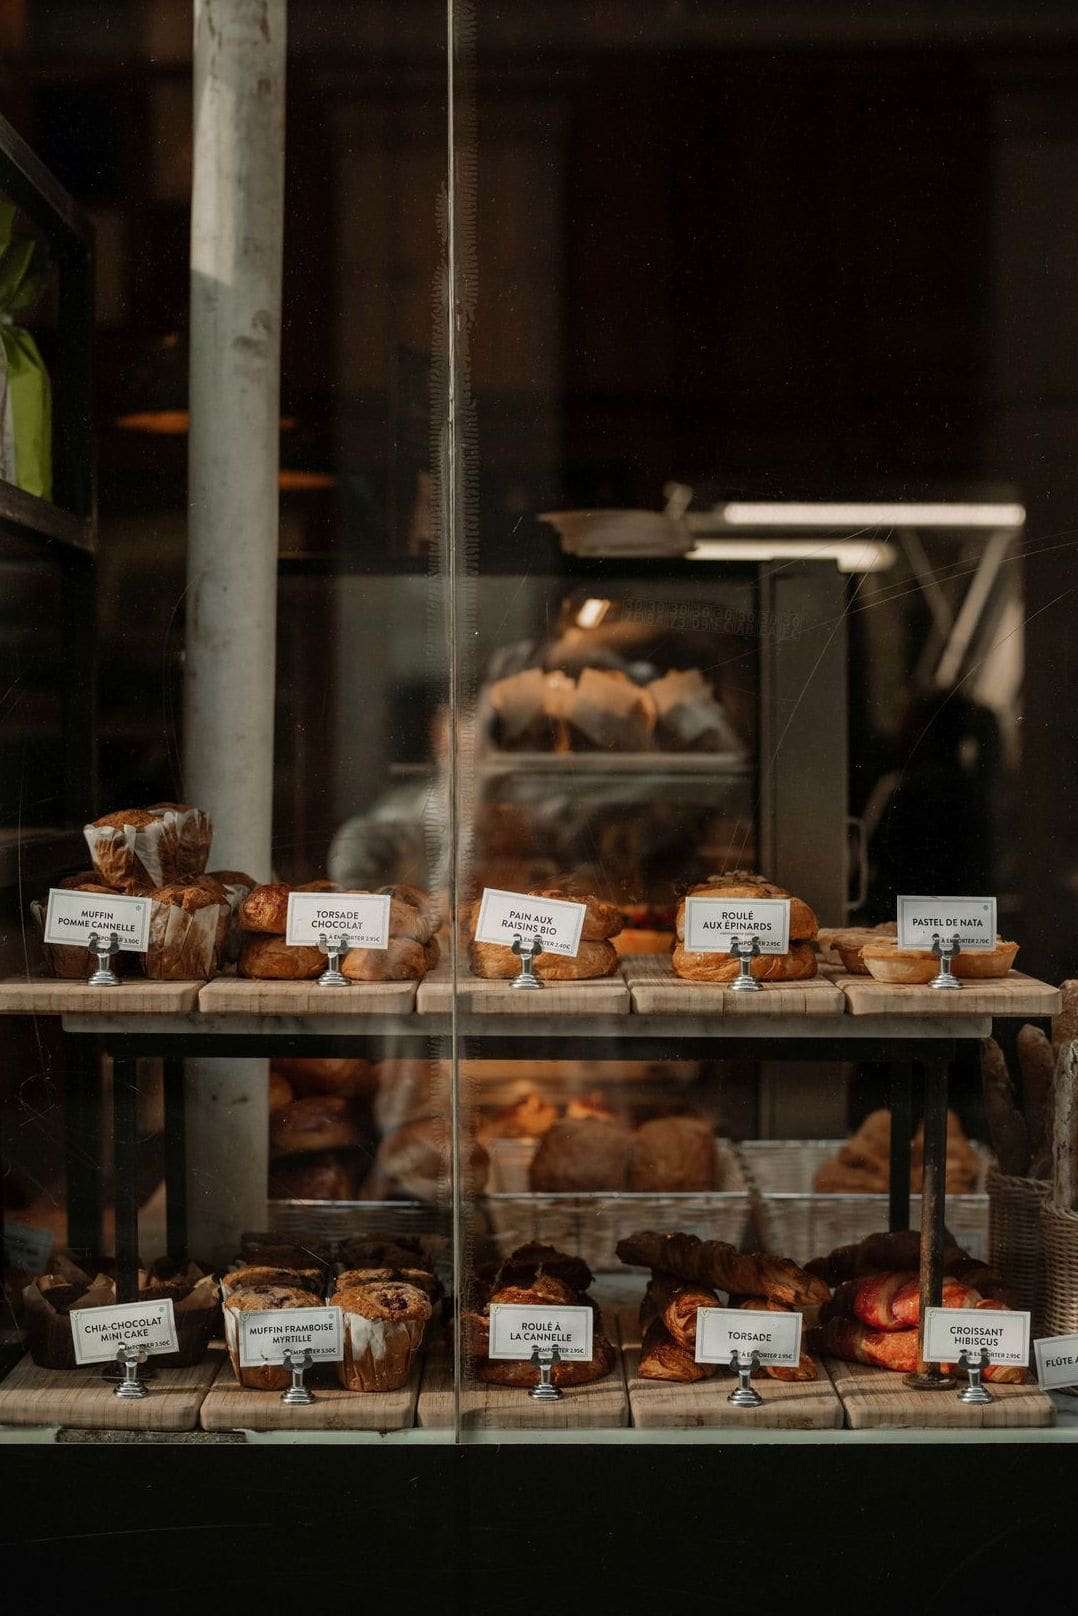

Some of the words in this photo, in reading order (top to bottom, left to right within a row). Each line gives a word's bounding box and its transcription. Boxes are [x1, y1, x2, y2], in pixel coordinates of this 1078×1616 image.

[81, 910, 114, 920] MUFFIN
[316, 910, 359, 919] TORSADE
[510, 910, 531, 921] PAIN
[533, 915, 553, 925] AUX
[722, 911, 754, 920] ROULÉ
[58, 917, 90, 928] POMME
[92, 921, 136, 932] CANNELLE
[312, 920, 363, 930] CHOCOLAT
[703, 922, 722, 930] AUX
[724, 920, 772, 931] ÉPINARDS
[912, 918, 944, 926] PASTEL
[946, 918, 958, 926] DE
[960, 919, 983, 927] NATA
[502, 920, 538, 933] RAISINS
[540, 926, 557, 936] BIO
[84, 1317, 162, 1333] CHIA-CHOCOLAT
[250, 1326, 282, 1335] MUFFIN
[285, 1323, 334, 1332] FRAMBOISE
[522, 1322, 552, 1331] ROULÉ
[555, 1322, 561, 1331] À
[101, 1332, 122, 1342] MINI
[124, 1329, 149, 1339] CAKE
[950, 1326, 1004, 1336] CROISSANT
[272, 1334, 312, 1344] MYRTILLE
[524, 1333, 572, 1342] CANNELLE
[728, 1331, 772, 1342] TORSADE
[954, 1337, 999, 1346] HIBISCUS
[1046, 1357, 1073, 1367] FLÛTE
